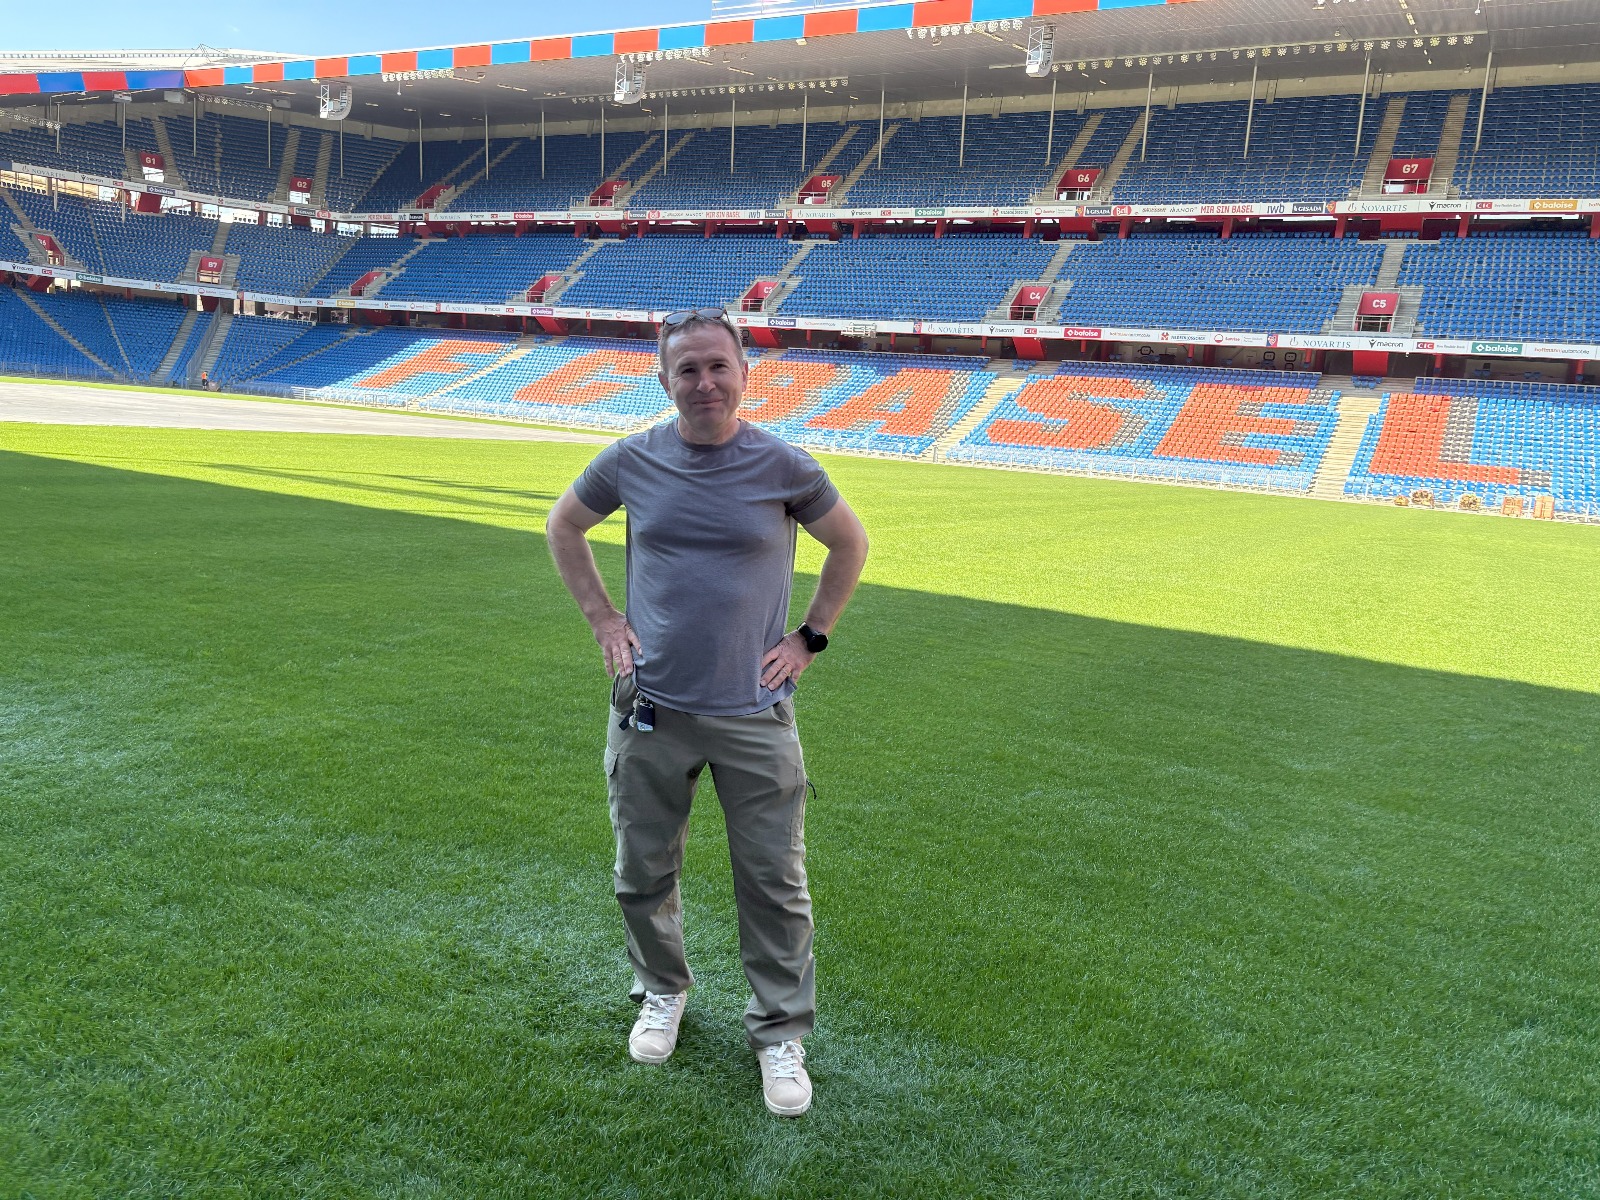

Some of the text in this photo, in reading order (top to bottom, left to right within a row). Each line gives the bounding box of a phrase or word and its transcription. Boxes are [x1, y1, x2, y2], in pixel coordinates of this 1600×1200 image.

[146, 156, 155, 164] G1
[1402, 164, 1418, 174] G7
[32, 168, 66, 179] NOVARTIS
[1078, 174, 1090, 182] G6
[1200, 204, 1254, 214] MIR SIN BASEL
[1362, 203, 1408, 212] NOVARTIS
[1030, 292, 1040, 300] C4
[1372, 300, 1386, 308] C5
[1074, 329, 1099, 337] baloise
[1302, 340, 1352, 348] NOVARTIS
[1484, 344, 1518, 352] baloise
